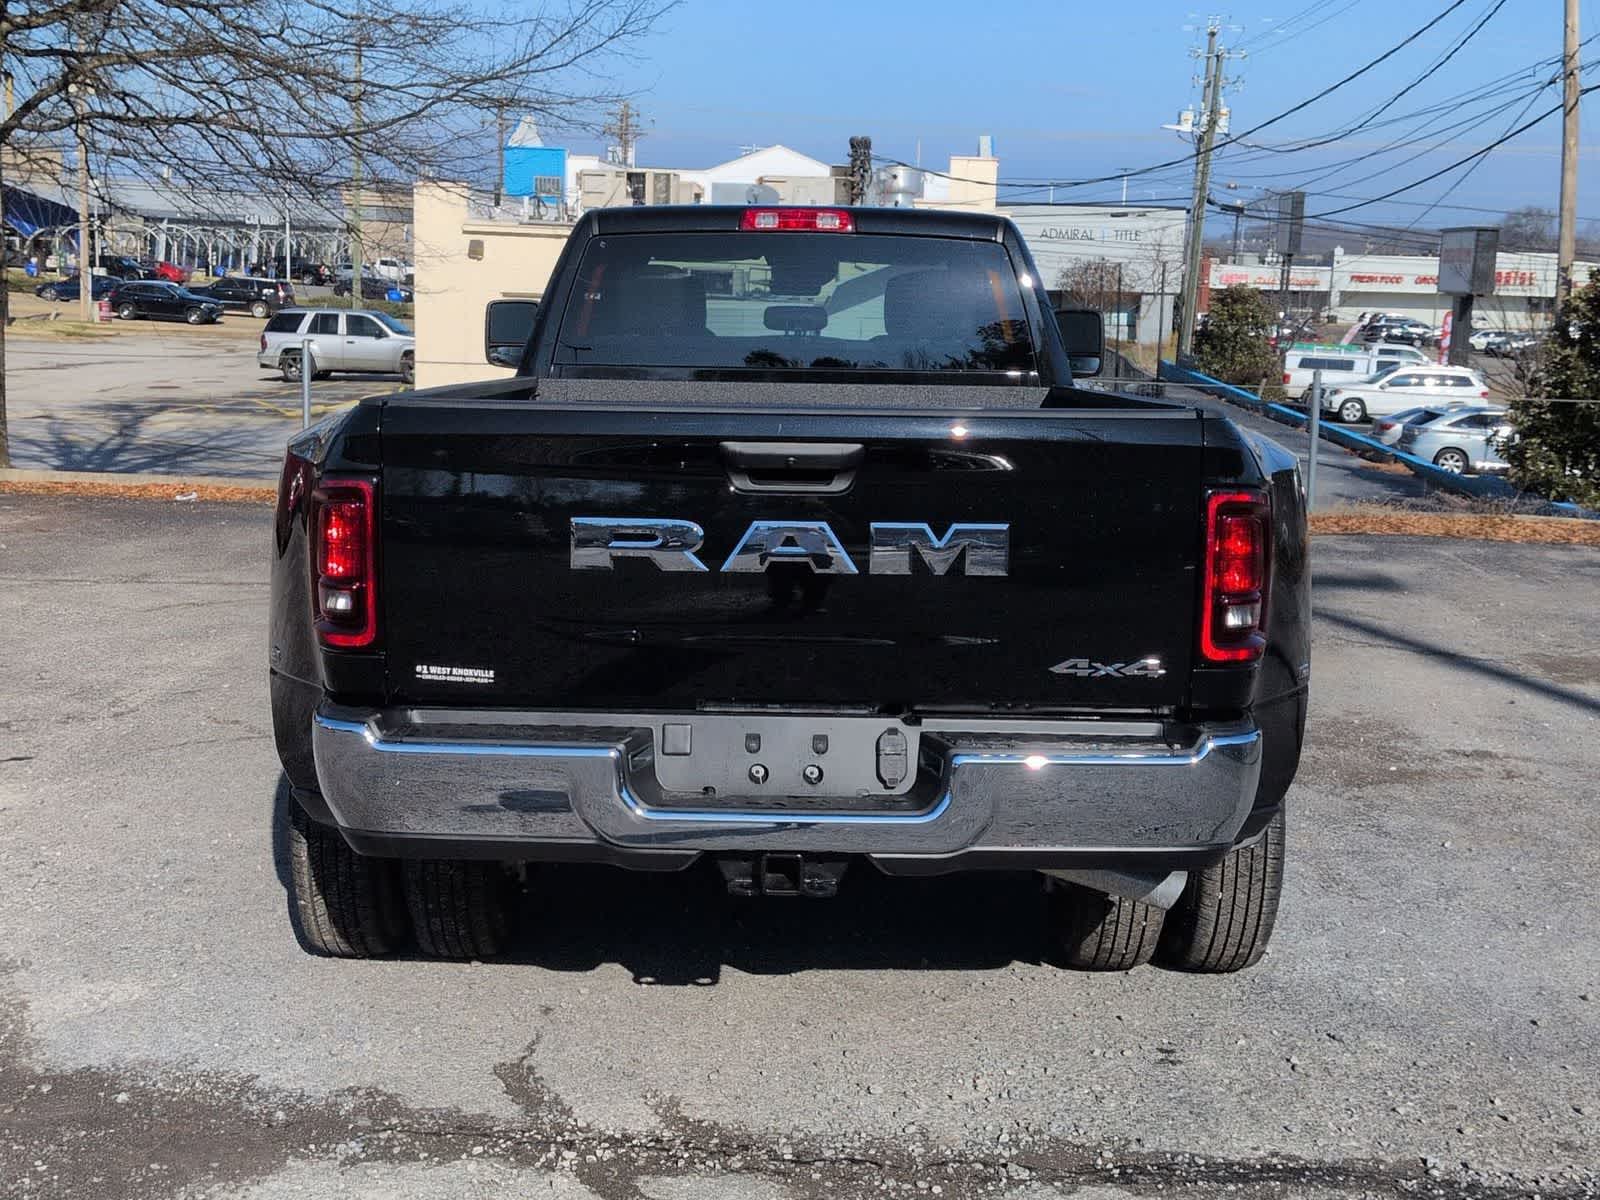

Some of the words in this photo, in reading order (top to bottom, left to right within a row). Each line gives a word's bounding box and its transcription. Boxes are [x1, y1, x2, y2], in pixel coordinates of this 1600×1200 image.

[1040, 228, 1095, 241] ADMIRAL
[1113, 229, 1142, 241] TITLE
[570, 517, 1010, 577] RAM
[429, 665, 451, 676] WEST
[452, 667, 495, 679] KNOXVILLE
